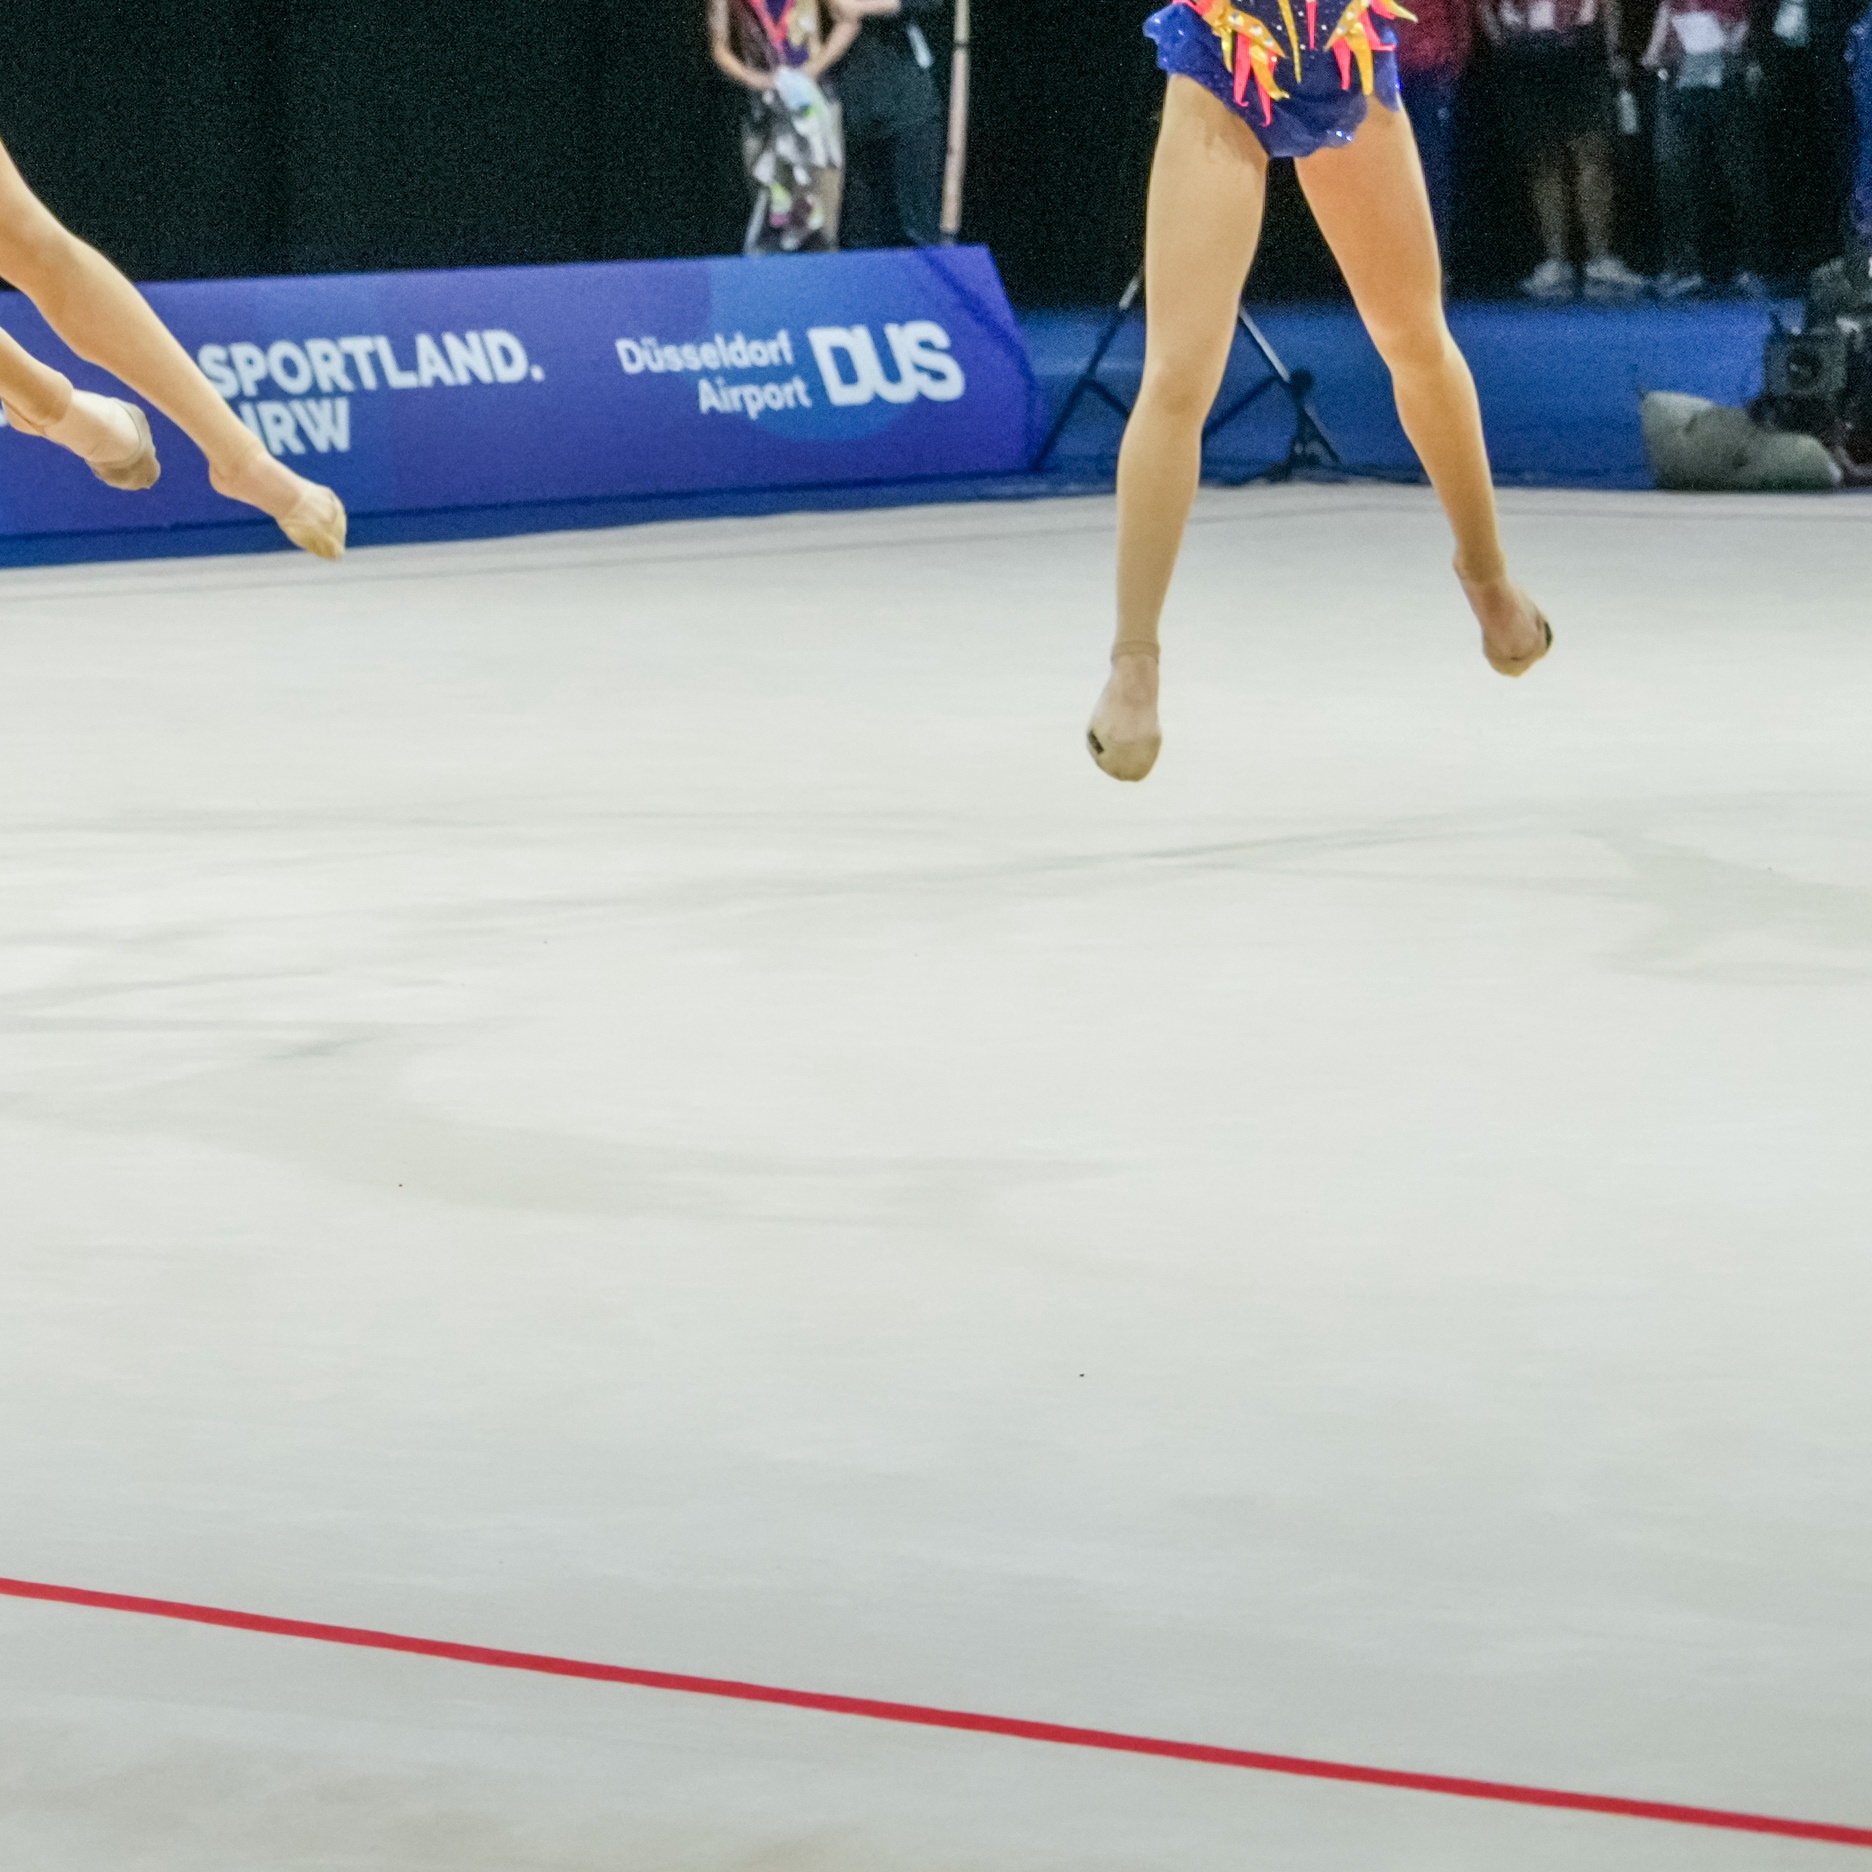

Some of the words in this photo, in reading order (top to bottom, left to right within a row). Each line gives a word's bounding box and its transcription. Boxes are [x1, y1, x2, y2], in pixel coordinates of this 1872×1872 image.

[198, 328, 546, 399] SPORTLAND.
[614, 328, 794, 375] Düsseldorf
[807, 319, 966, 407] DUS
[698, 375, 813, 420] Airport
